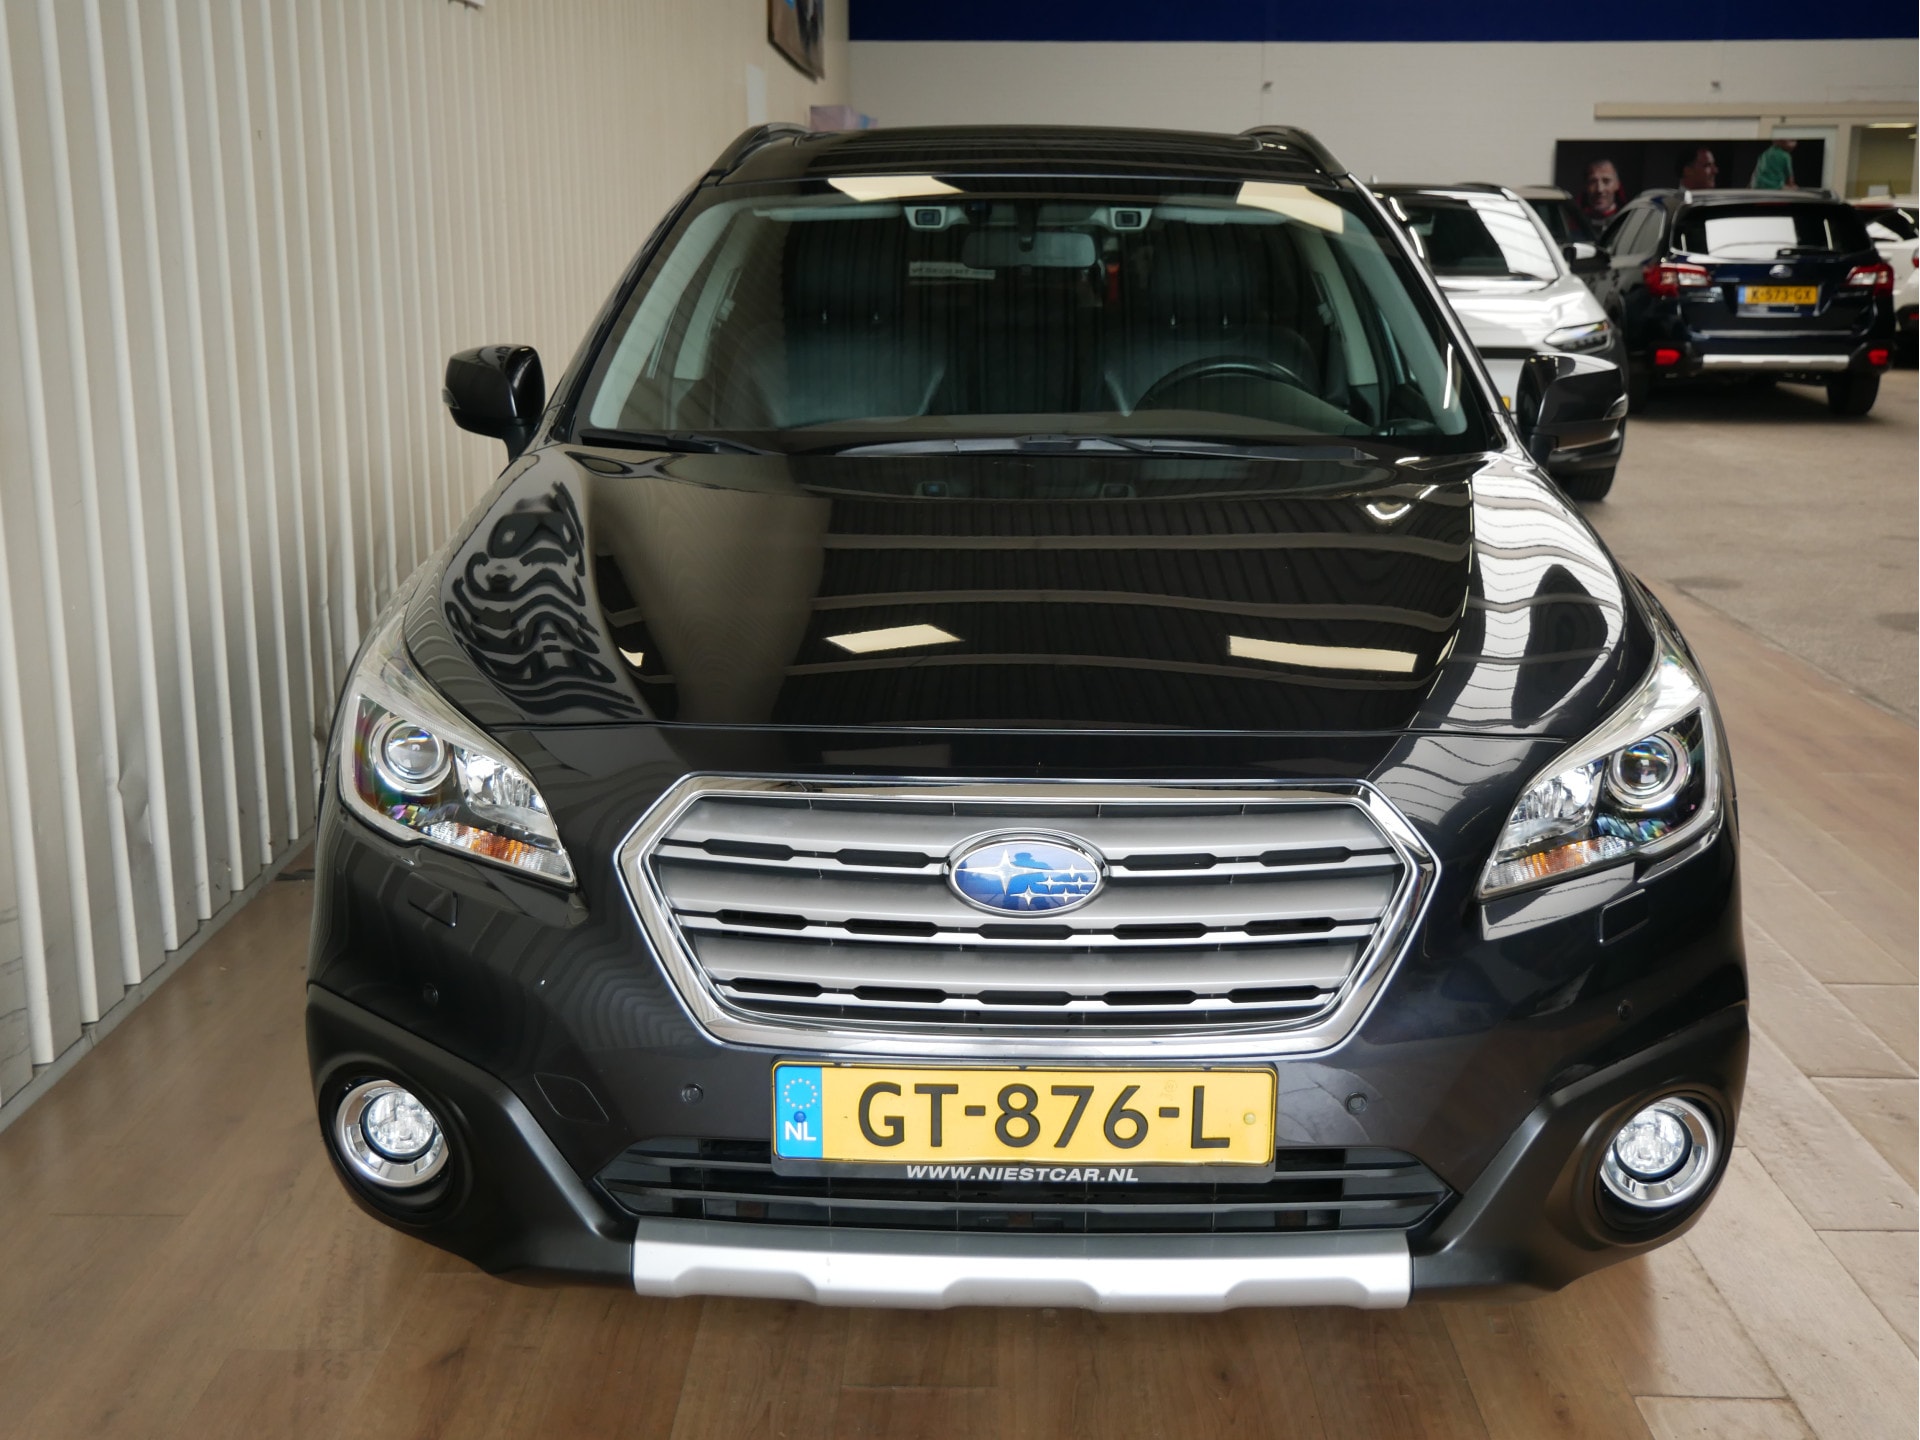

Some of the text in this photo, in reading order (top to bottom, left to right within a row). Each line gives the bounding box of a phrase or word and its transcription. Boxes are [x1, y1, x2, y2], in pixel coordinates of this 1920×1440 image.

[857, 1081, 1230, 1149] GT-876-L
[784, 1121, 817, 1142] NL
[905, 1164, 1139, 1182] WWW.NIESTCAR.NL
